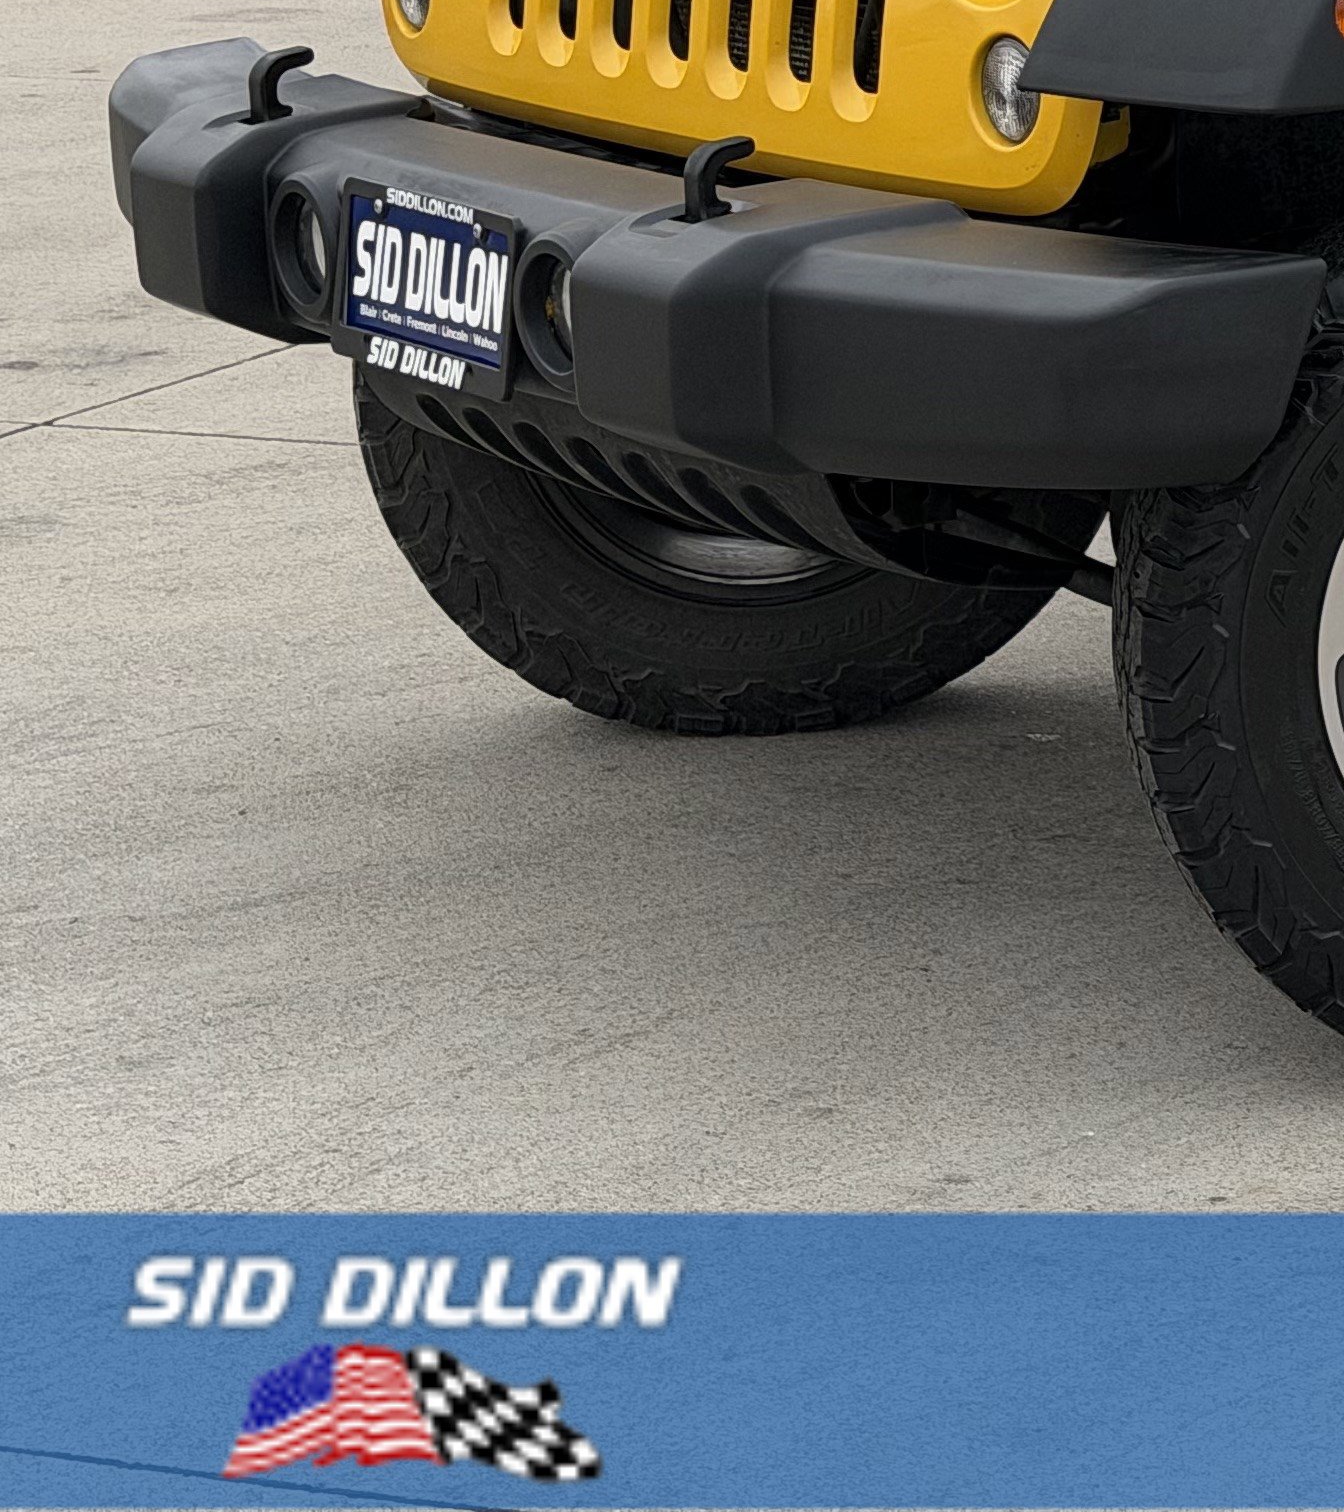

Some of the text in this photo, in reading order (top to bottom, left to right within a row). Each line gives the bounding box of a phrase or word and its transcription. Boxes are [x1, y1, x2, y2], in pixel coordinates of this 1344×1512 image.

[386, 187, 474, 225] SIDDILLON.COM
[352, 219, 509, 334] SID DILLON
[366, 336, 466, 390] SID DILLON
